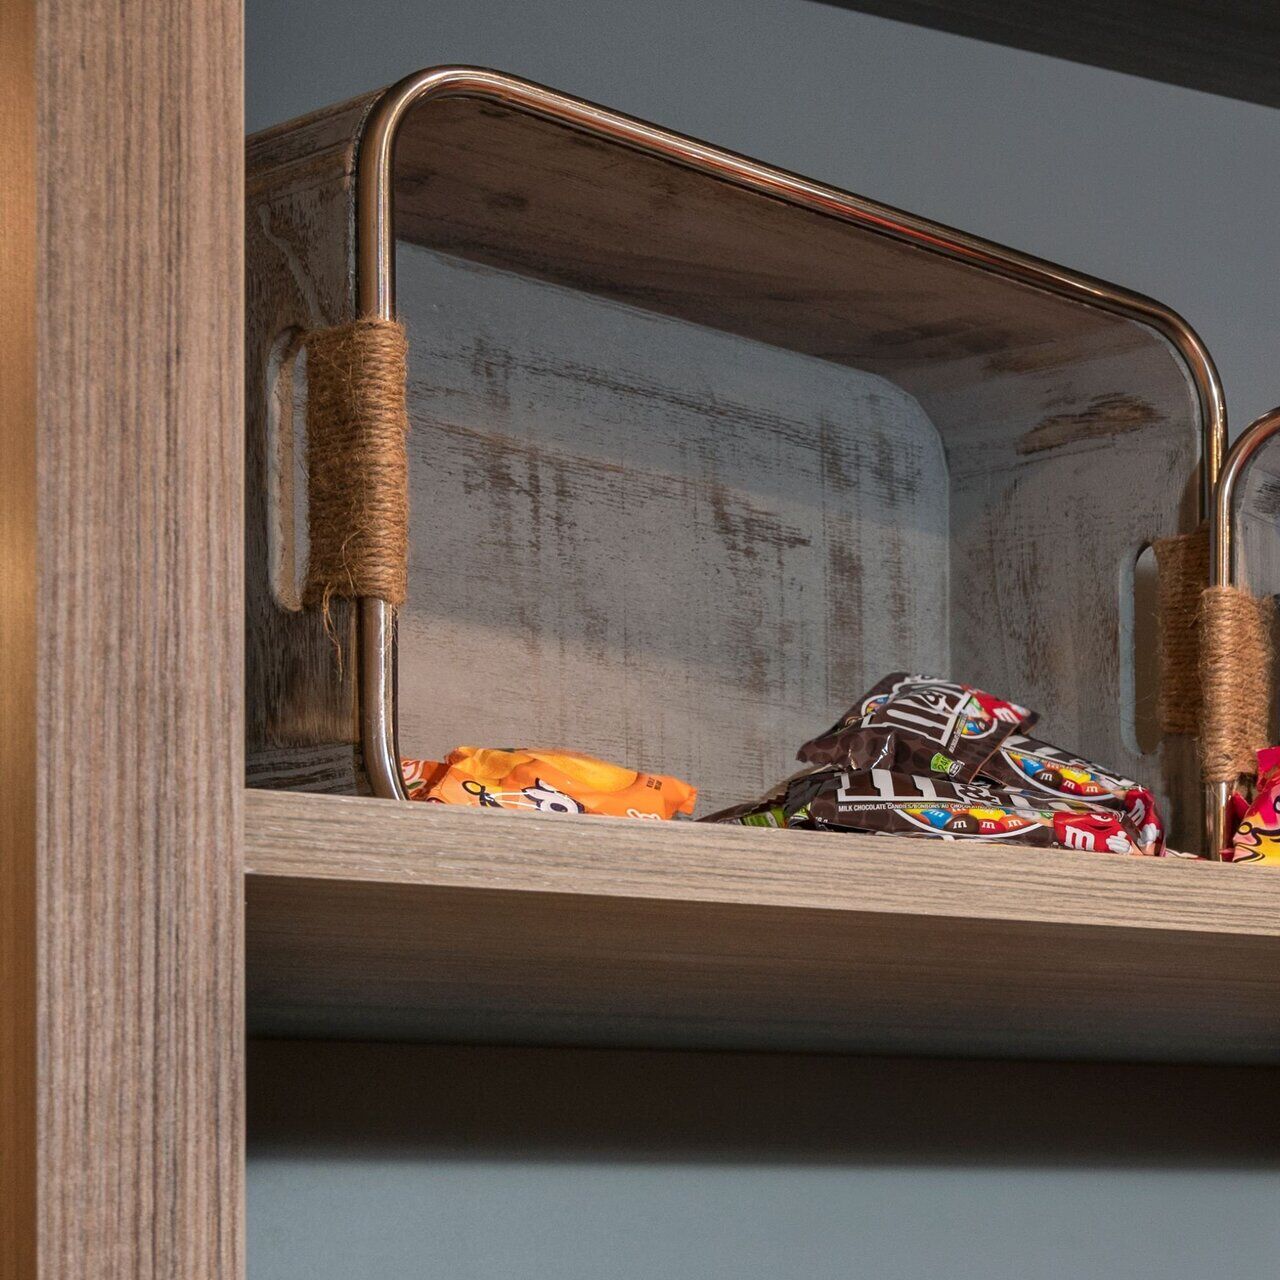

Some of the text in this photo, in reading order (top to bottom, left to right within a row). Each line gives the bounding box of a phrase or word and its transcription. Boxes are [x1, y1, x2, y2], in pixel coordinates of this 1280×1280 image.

[838, 804, 853, 812] MILK
[854, 802, 887, 811] CHOCOLATE
[1064, 825, 1096, 851] m
